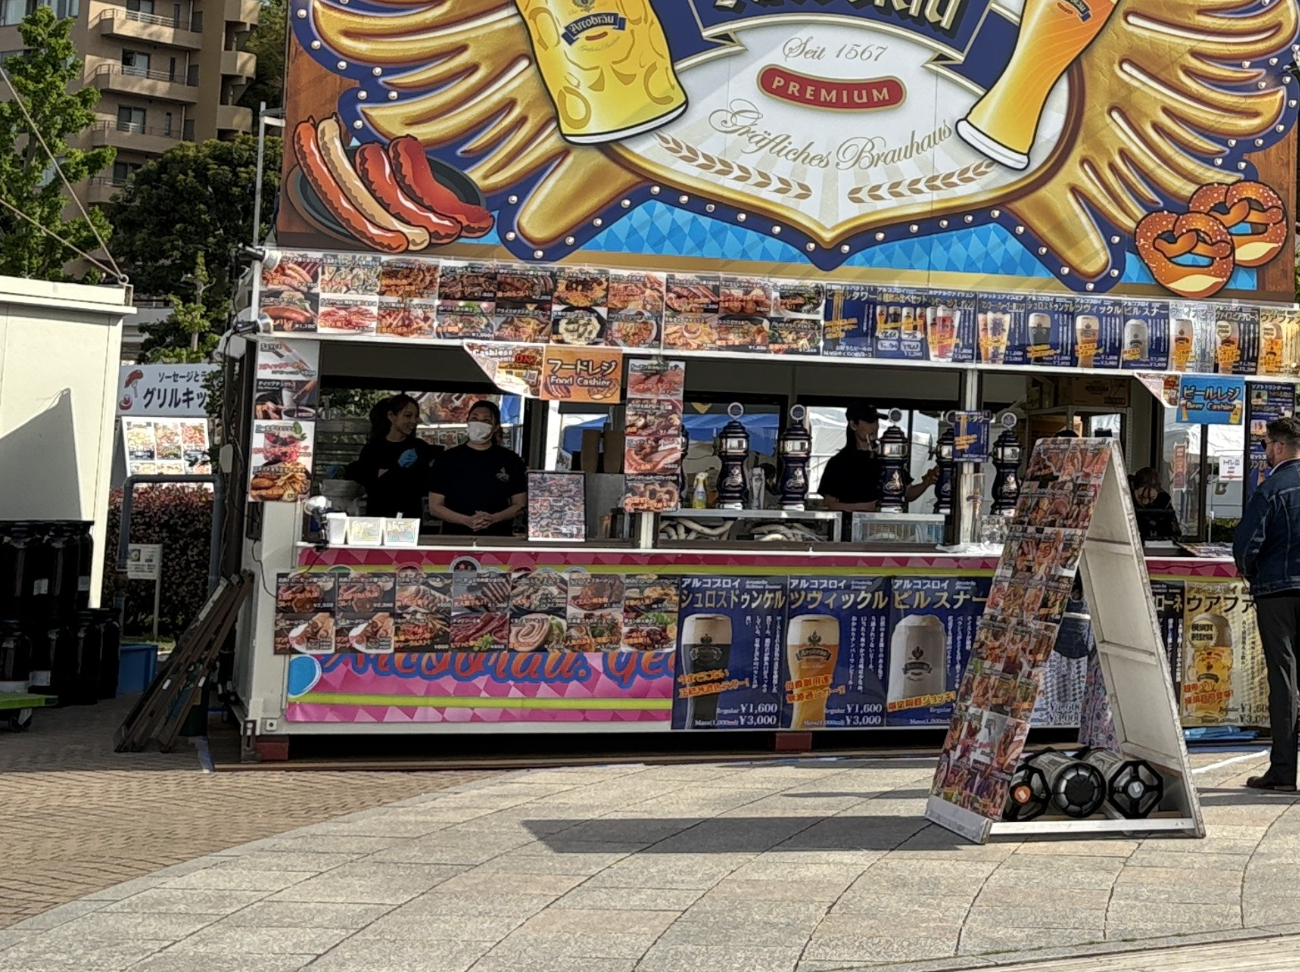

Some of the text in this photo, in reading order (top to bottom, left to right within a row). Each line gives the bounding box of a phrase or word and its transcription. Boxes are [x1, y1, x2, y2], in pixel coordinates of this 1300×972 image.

[782, 36, 888, 62] Seit 1567
[771, 76, 890, 104] PREMIUM
[708, 98, 952, 170] Gräfliches Brauhaus
[548, 360, 618, 376] フードレジ
[550, 375, 613, 387] Food Cashier
[1183, 387, 1241, 401] ビールレジ
[1186, 402, 1235, 411] Beer Cashier
[681, 578, 741, 588] アルコブロイ
[790, 579, 847, 589] アルコブロイ
[894, 579, 950, 589] アルコブロイ
[680, 590, 785, 609] シュロスドゥンケル
[790, 591, 889, 610] ツヴィックル
[894, 590, 988, 610] ピルスナー
[740, 703, 778, 714] ¥1,600
[846, 703, 883, 714] ¥1,600
[739, 715, 777, 726] ¥3,000
[845, 715, 881, 725] ¥3,000
